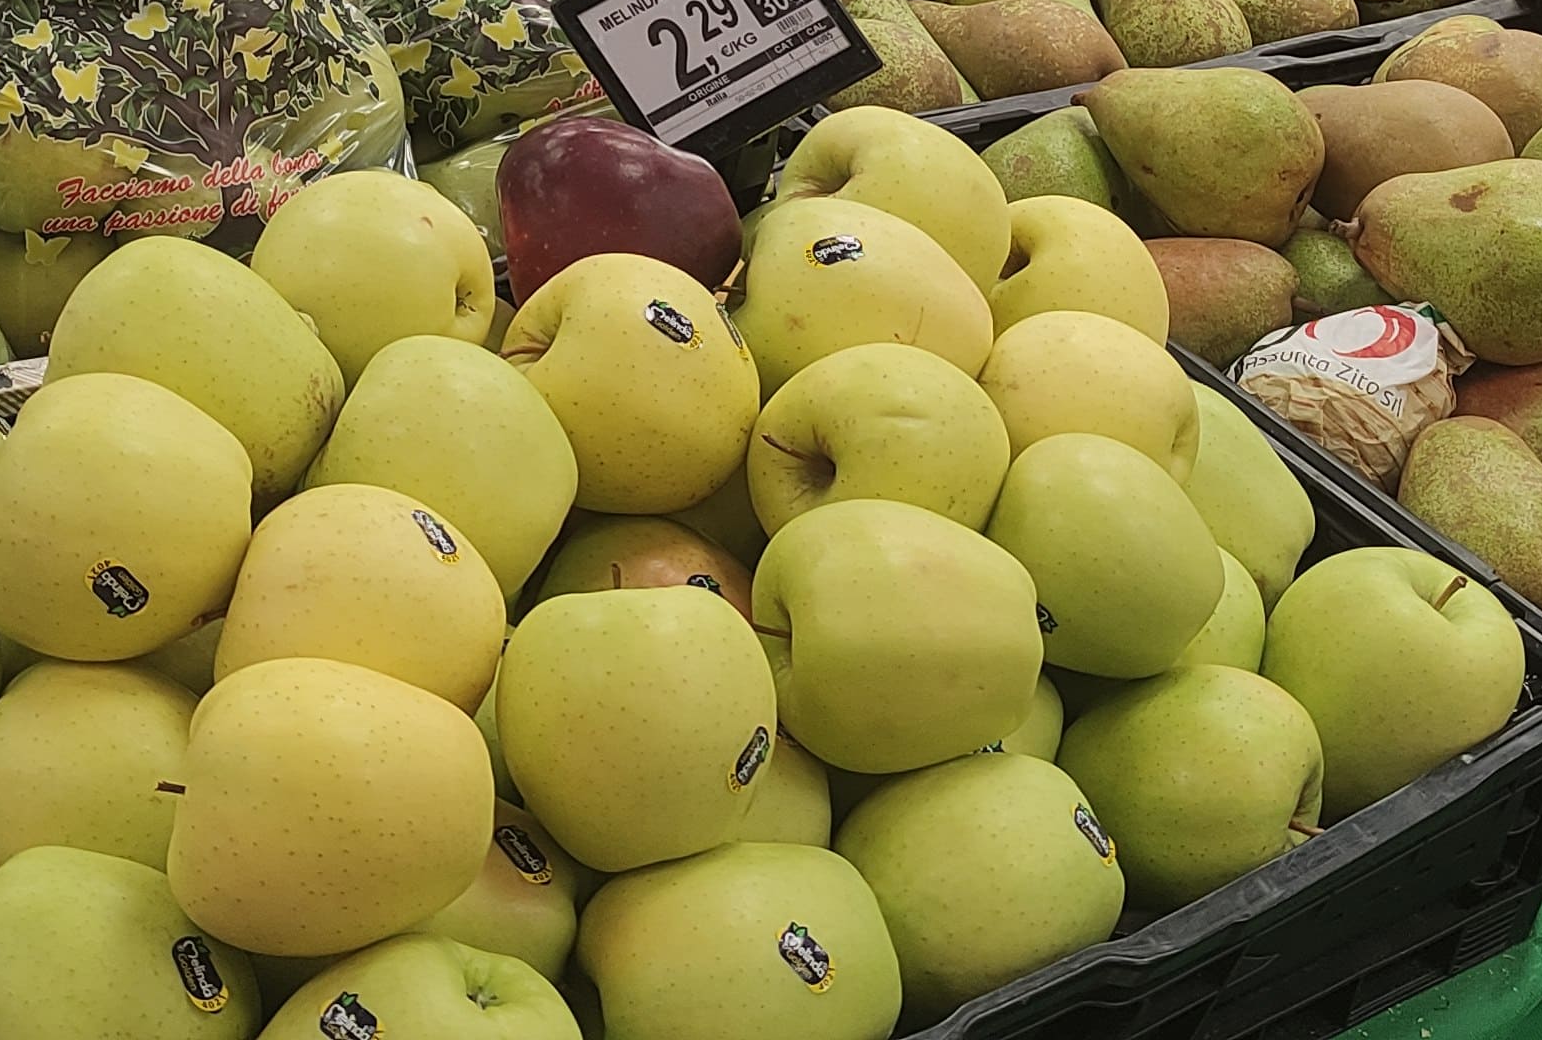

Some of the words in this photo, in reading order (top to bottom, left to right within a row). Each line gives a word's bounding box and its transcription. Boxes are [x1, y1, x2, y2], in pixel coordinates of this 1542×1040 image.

[688, 74, 732, 103] ORIGINE
[773, 39, 795, 55] CAT
[805, 22, 827, 37] CAL
[720, 32, 759, 58] €/KG
[56, 172, 193, 209] Facciamo
[202, 158, 265, 189] della
[42, 214, 98, 235] una
[103, 202, 225, 237] passione
[232, 190, 259, 218] di
[1335, 362, 1382, 396] Zito
[101, 571, 140, 611] Melinda
[183, 940, 213, 998] Melinda
[782, 931, 827, 979] Melinda
